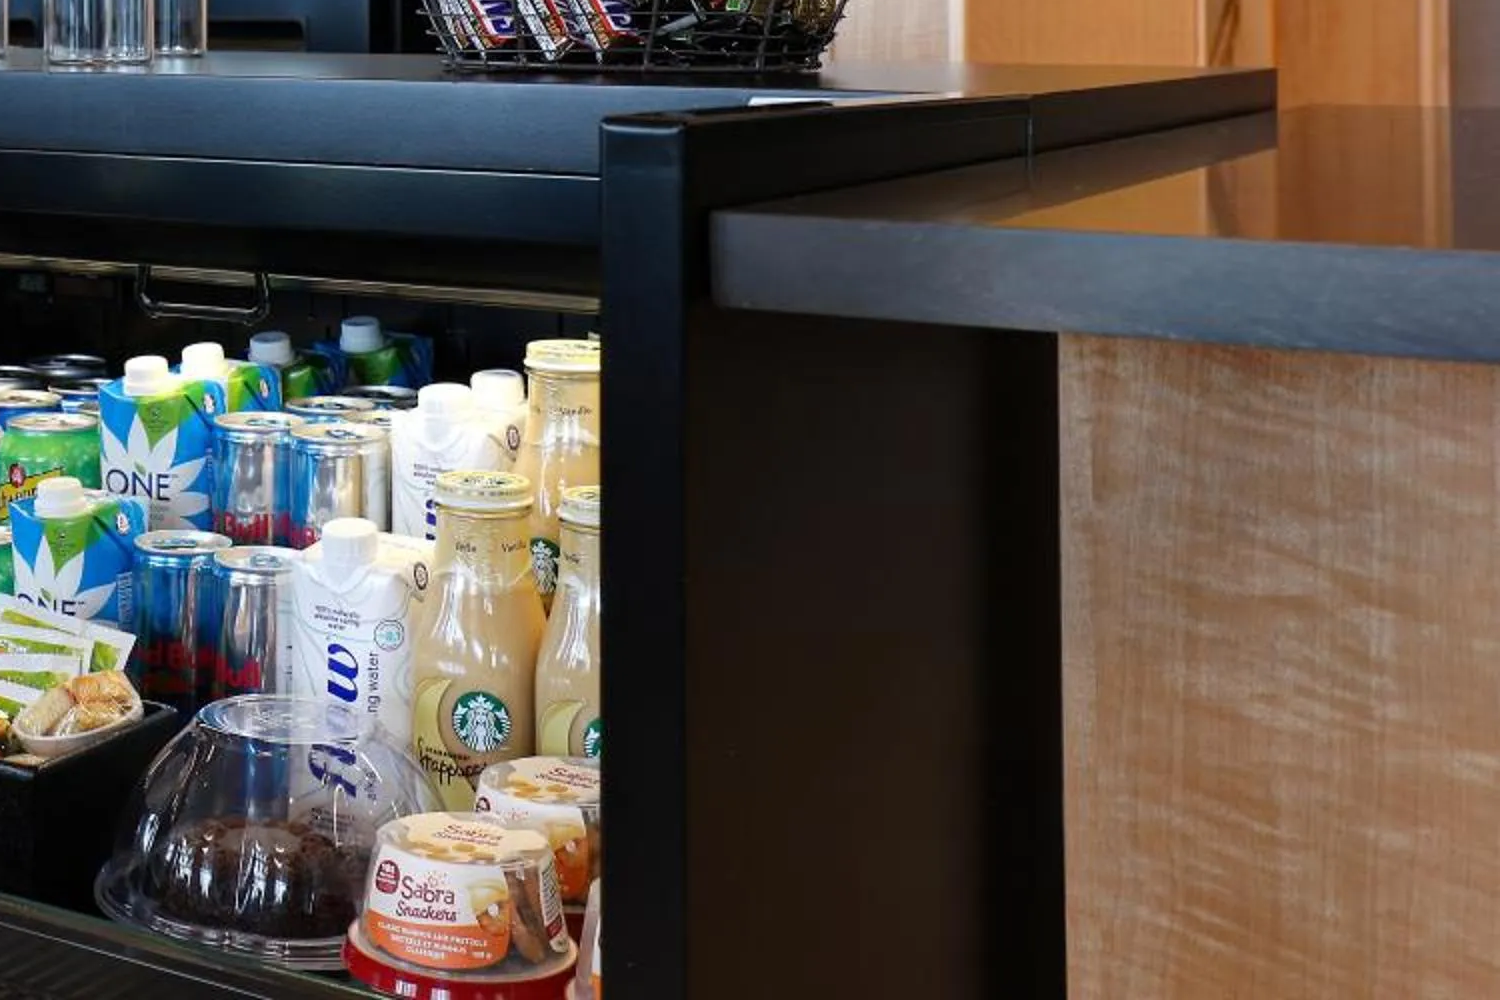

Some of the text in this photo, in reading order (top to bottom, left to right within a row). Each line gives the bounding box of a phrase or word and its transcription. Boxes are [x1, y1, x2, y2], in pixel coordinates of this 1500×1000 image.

[105, 468, 171, 501] ONE
[367, 652, 380, 693] water
[400, 875, 456, 905] Sabra
[395, 900, 458, 922] Snackers
